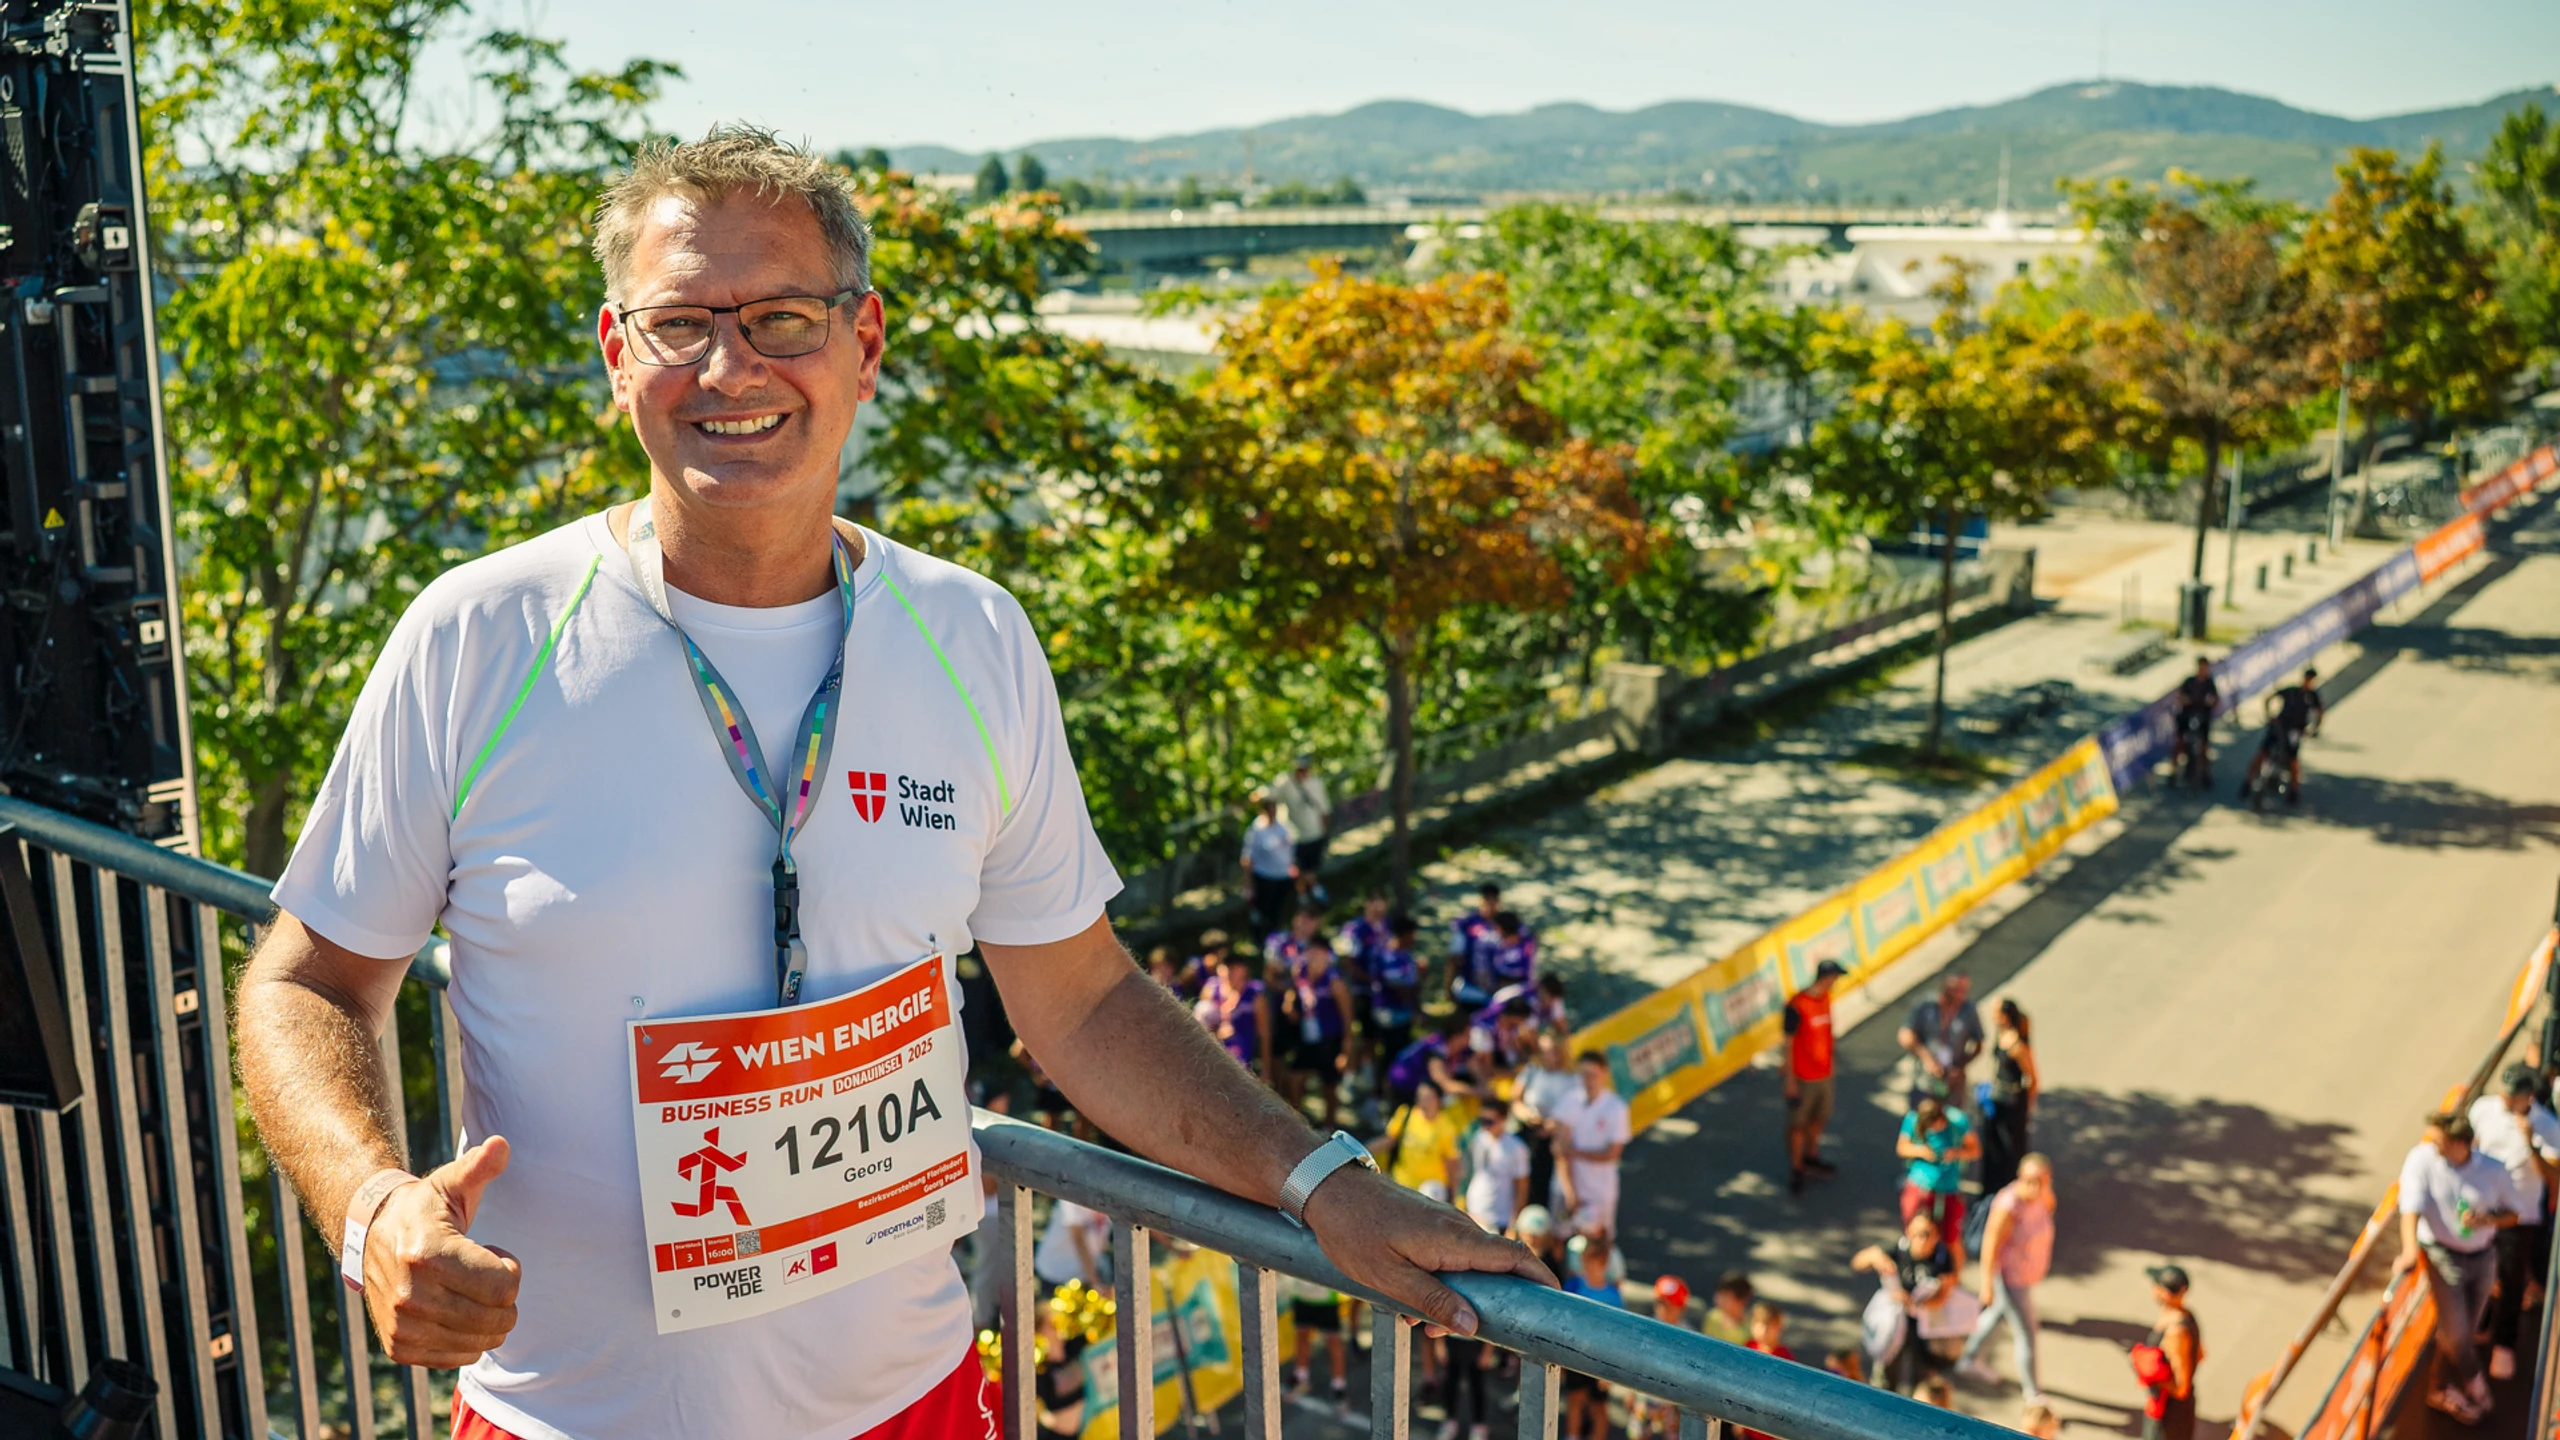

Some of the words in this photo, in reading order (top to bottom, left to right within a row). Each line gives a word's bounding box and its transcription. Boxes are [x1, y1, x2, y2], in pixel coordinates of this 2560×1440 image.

[898, 775, 955, 804] Stadt
[900, 802, 956, 831] Wien
[733, 1031, 825, 1071] WIEN
[833, 986, 932, 1052] ENERGIE
[662, 1095, 772, 1123] BUSINESS
[779, 1084, 823, 1108] RUN
[834, 1056, 902, 1093] DONAUINSEL
[908, 1037, 933, 1063] 2025
[775, 1078, 943, 1176] 1210A
[844, 1156, 893, 1182] Georg
[857, 1175, 926, 1209] Bezirksvorstehung
[926, 1156, 963, 1180] Floridsdorf
[923, 1178, 944, 1193] Georg
[877, 1214, 924, 1239] DECATHLON
[686, 1253, 693, 1262] 3
[708, 1248, 734, 1259] 16:00
[694, 1266, 762, 1291] POWER
[787, 1258, 807, 1277] AK
[727, 1279, 763, 1300] ADE
